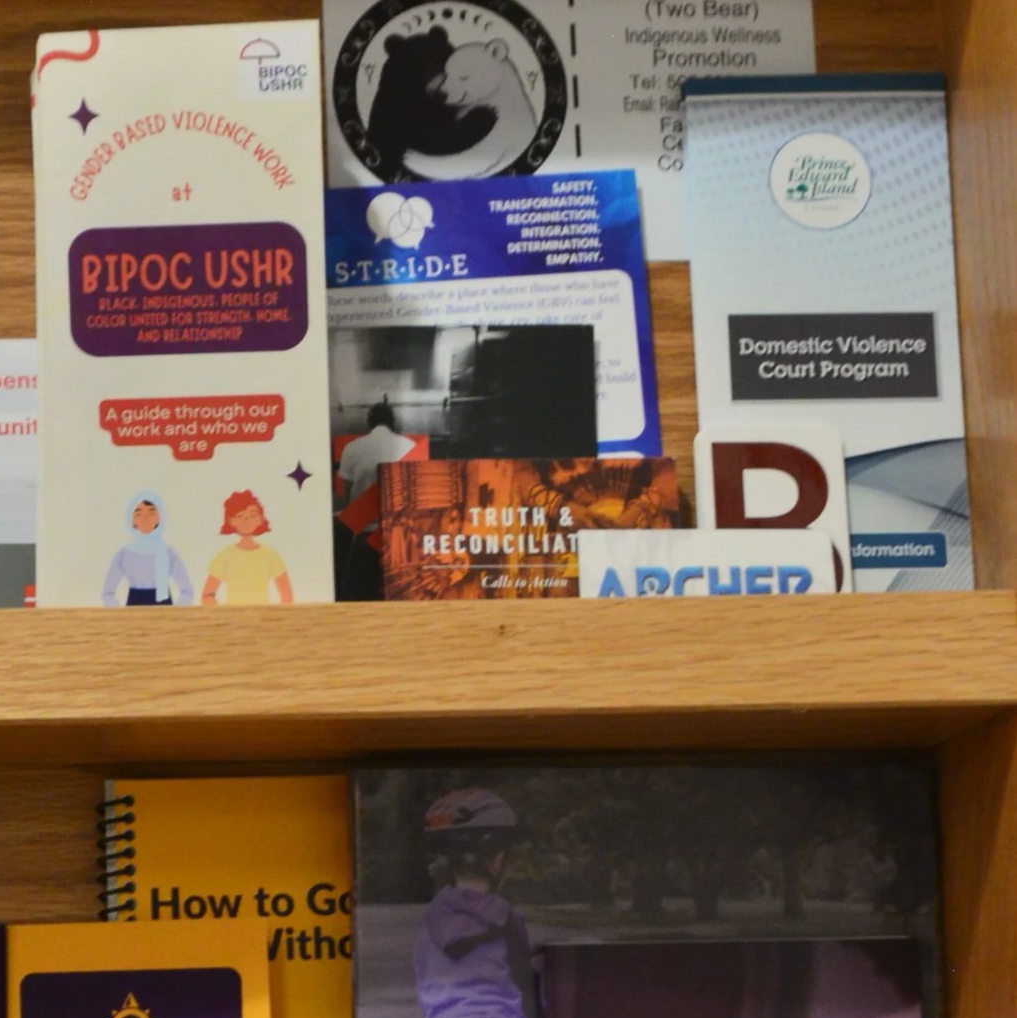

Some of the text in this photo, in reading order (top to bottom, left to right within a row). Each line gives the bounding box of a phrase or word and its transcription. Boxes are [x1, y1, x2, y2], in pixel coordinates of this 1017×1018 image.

[703, 0, 759, 21] Bear)
[625, 26, 782, 47] Indigenous Wellness
[652, 49, 757, 67] Promotion
[259, 64, 307, 78] BIPOC
[259, 78, 303, 92] USHR
[69, 110, 295, 201] GENDER BASED VIOLENCE WORK
[172, 183, 193, 201] at
[82, 249, 294, 294] BIPOC USHR
[740, 336, 926, 356] Domestic Violence
[759, 360, 909, 381] Court Program
[106, 403, 278, 424] A guide through our
[118, 421, 267, 437] work and who we
[179, 440, 207, 452] are
[470, 507, 573, 526] TRUTH &
[482, 576, 568, 589] Calls to Action
[151, 887, 294, 919] How to
